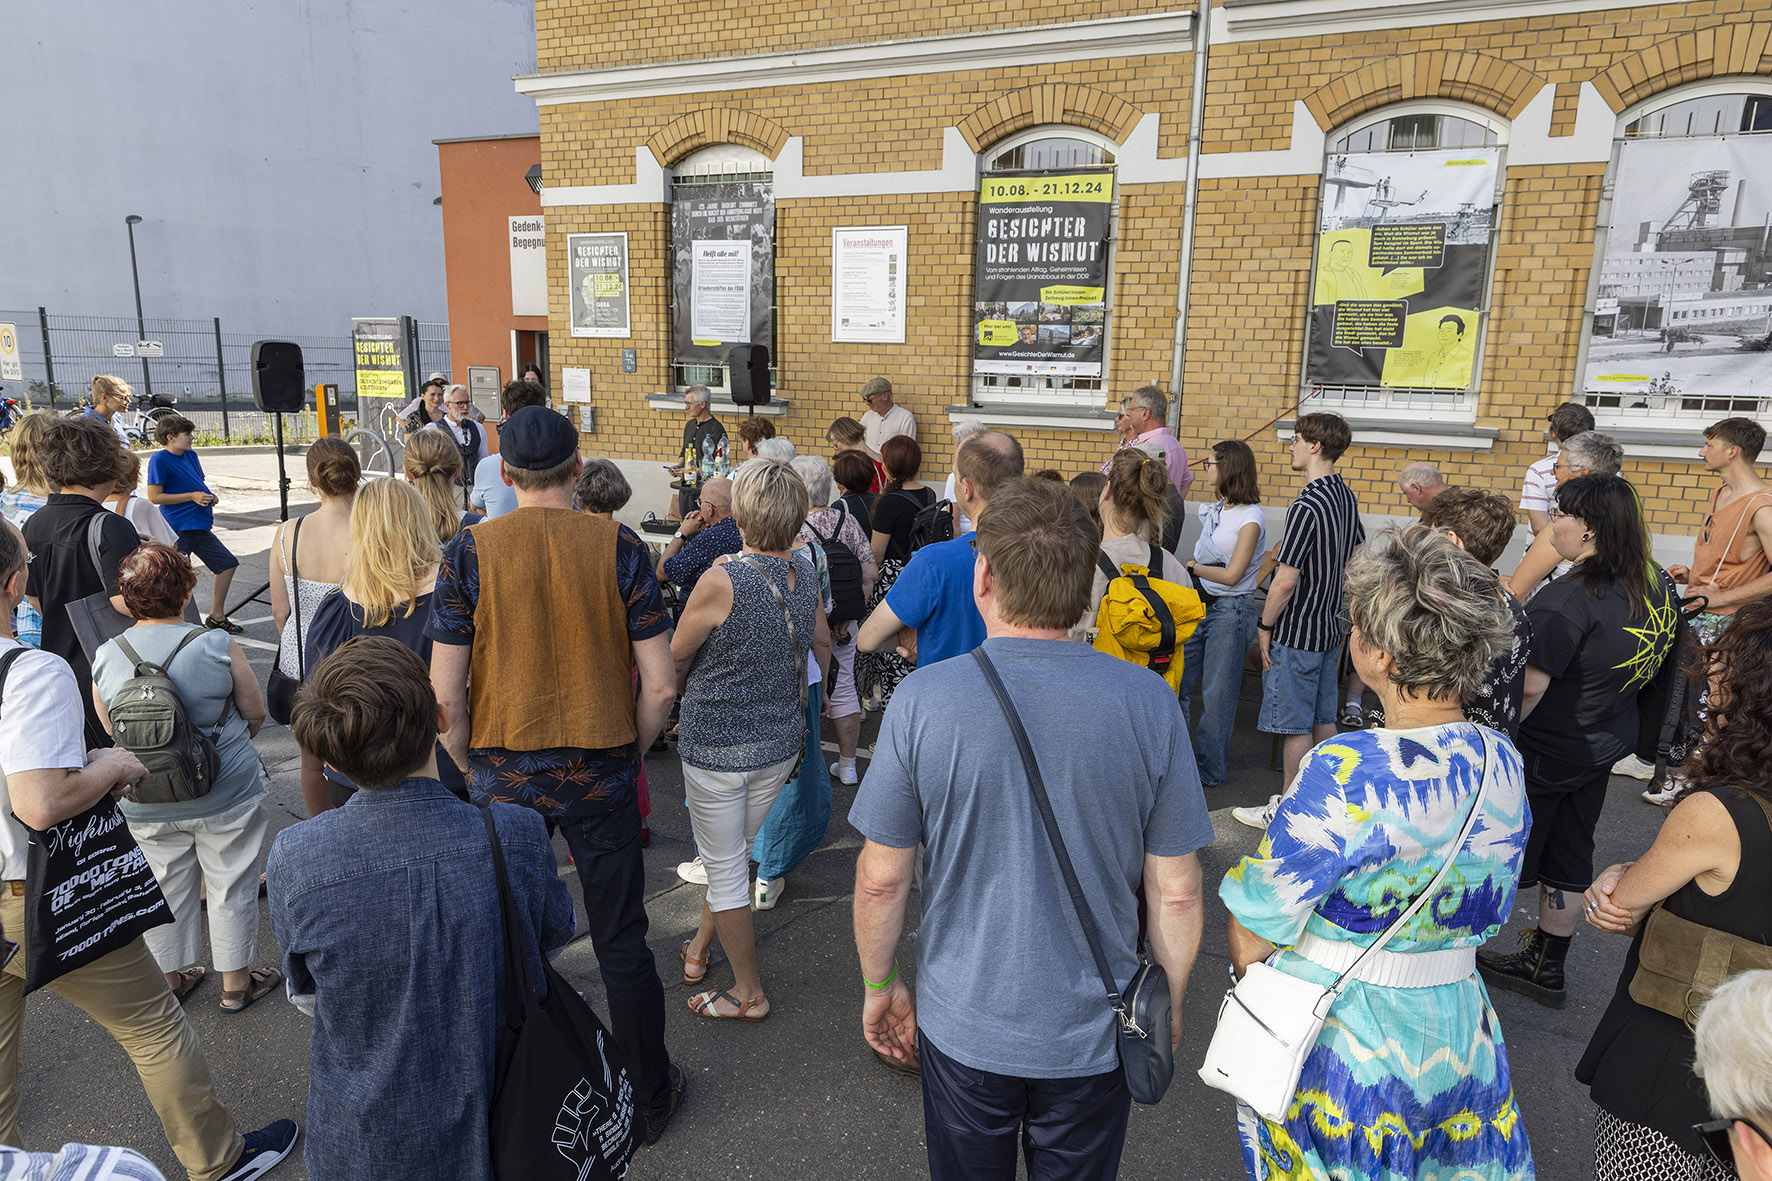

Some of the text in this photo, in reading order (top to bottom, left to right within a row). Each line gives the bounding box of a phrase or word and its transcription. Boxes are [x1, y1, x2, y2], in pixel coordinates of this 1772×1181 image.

[990, 185, 1029, 196] 10.08.
[1043, 182, 1102, 194] 21.12.24
[989, 206, 1053, 214] Wanderausstellung
[512, 220, 543, 232] Gedenk-
[988, 217, 1086, 239] GESICHTER
[843, 238, 893, 248] Veranstaltungen
[577, 246, 618, 256] GESICHTER
[987, 242, 1099, 263] DER WISMUT
[576, 257, 621, 267] DER WISMUT
[3, 335, 12, 348] 10
[356, 342, 394, 353] GESICHTER
[357, 354, 400, 365] DER WISMUT
[51, 855, 147, 912] OF METAL
[55, 914, 84, 935] January
